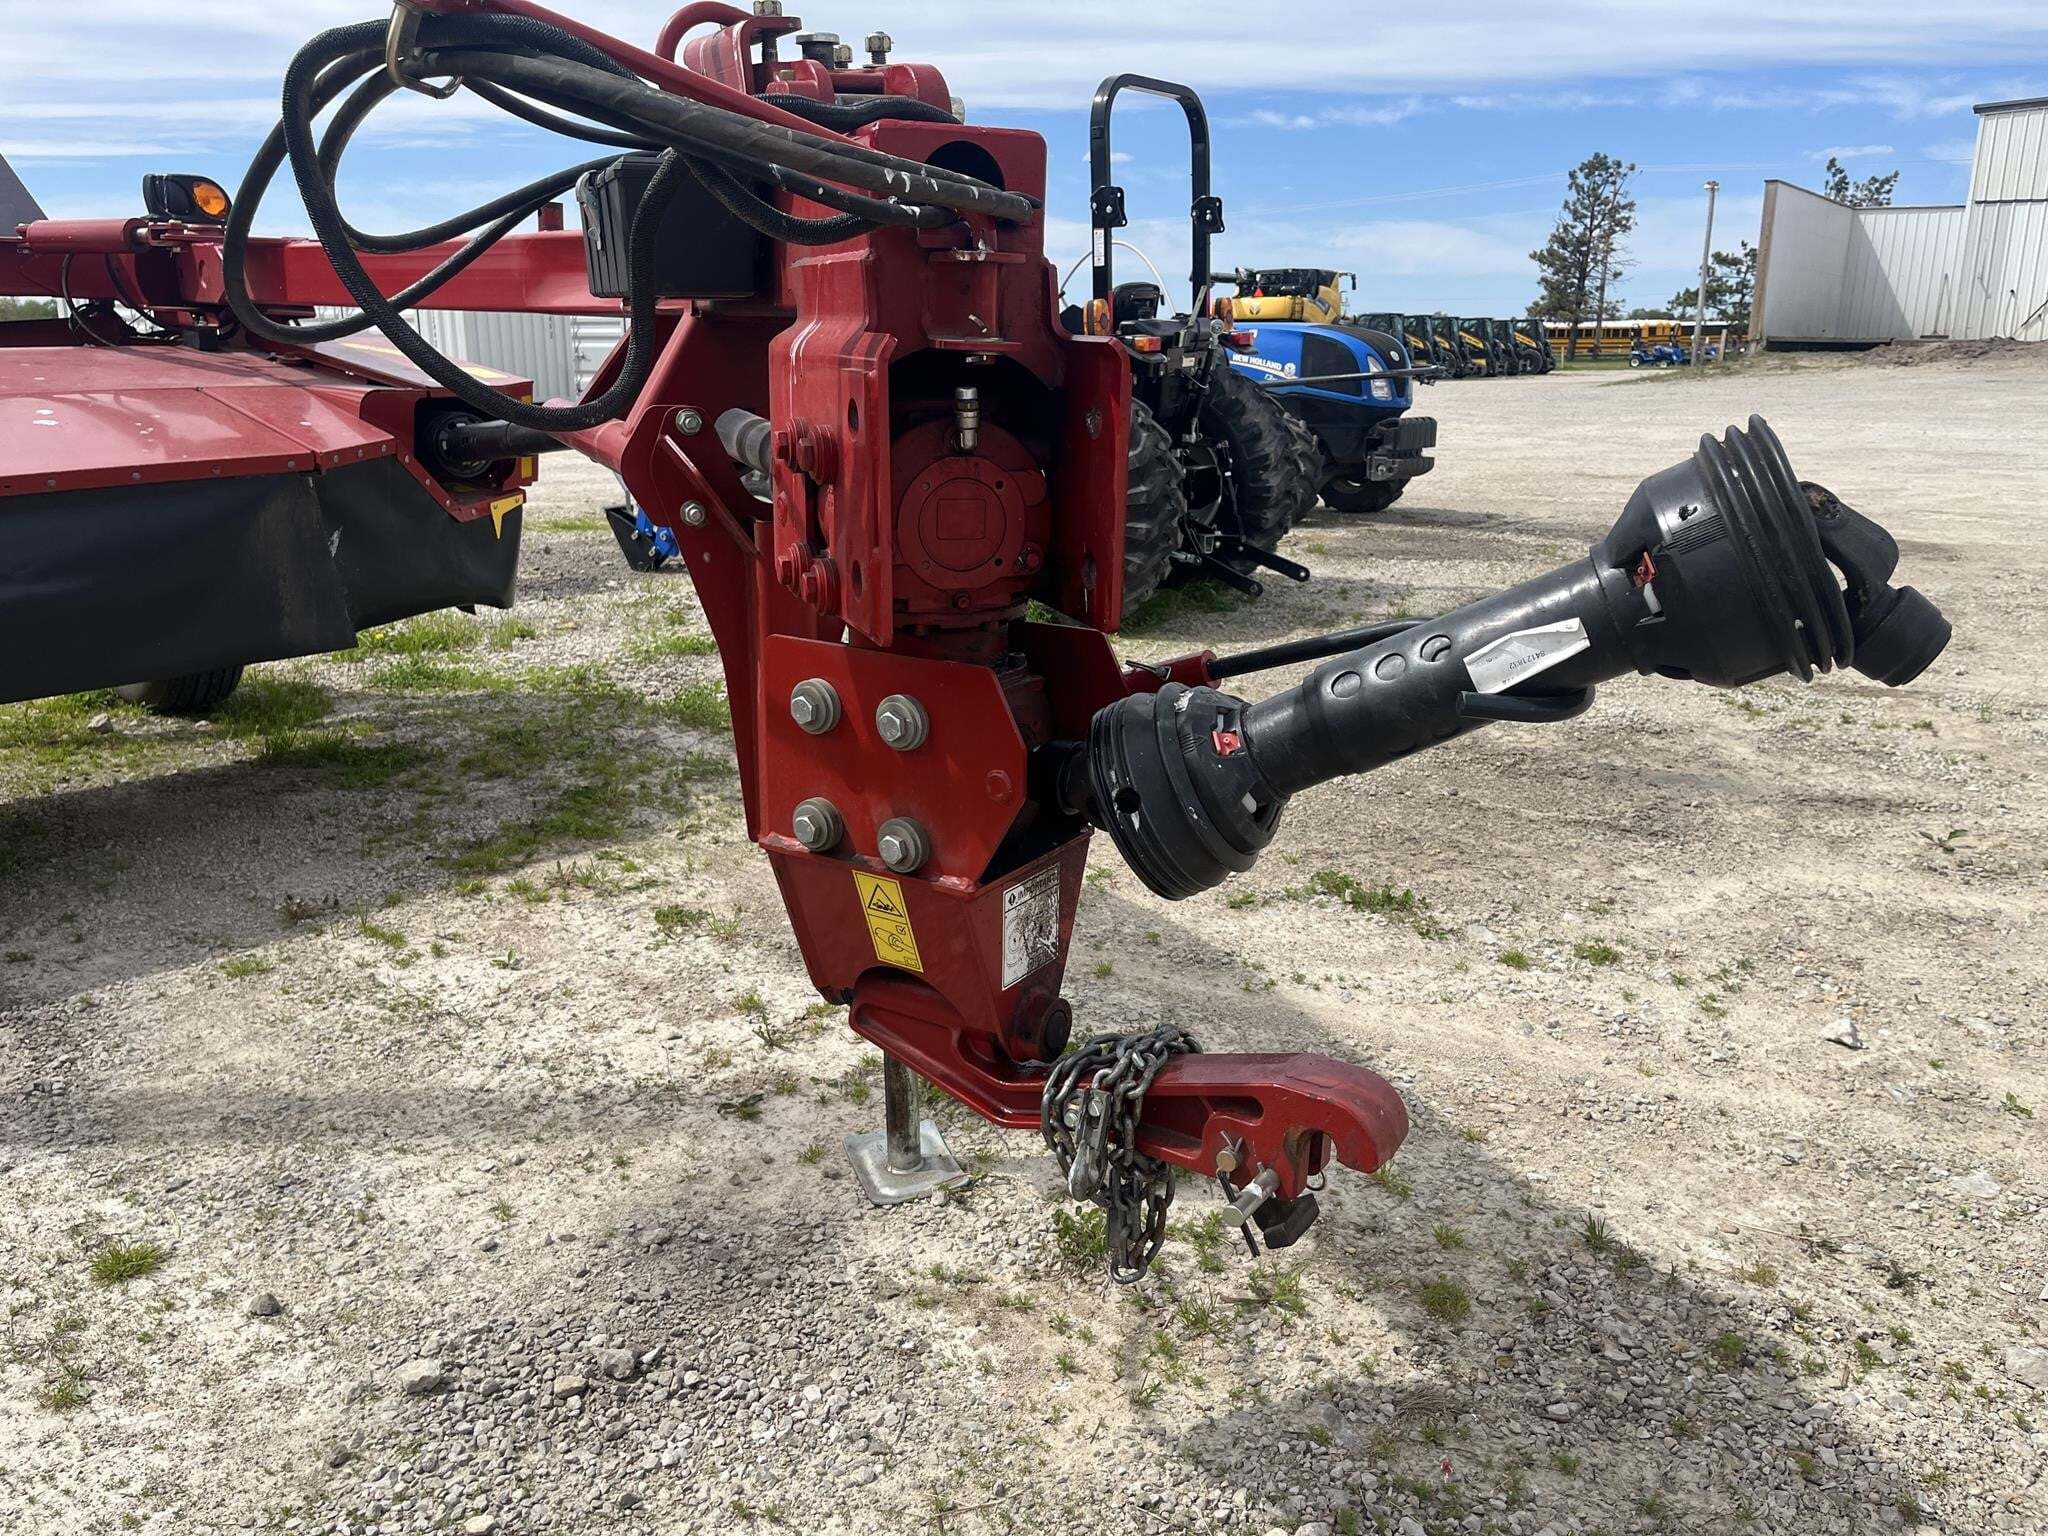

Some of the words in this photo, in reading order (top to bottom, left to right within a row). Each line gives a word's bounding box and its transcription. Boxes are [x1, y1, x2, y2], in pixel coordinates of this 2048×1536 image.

[1232, 354, 1249, 363] NEW
[1249, 356, 1282, 370] HOLLAND
[1017, 872, 1057, 901] IMPORTANT
